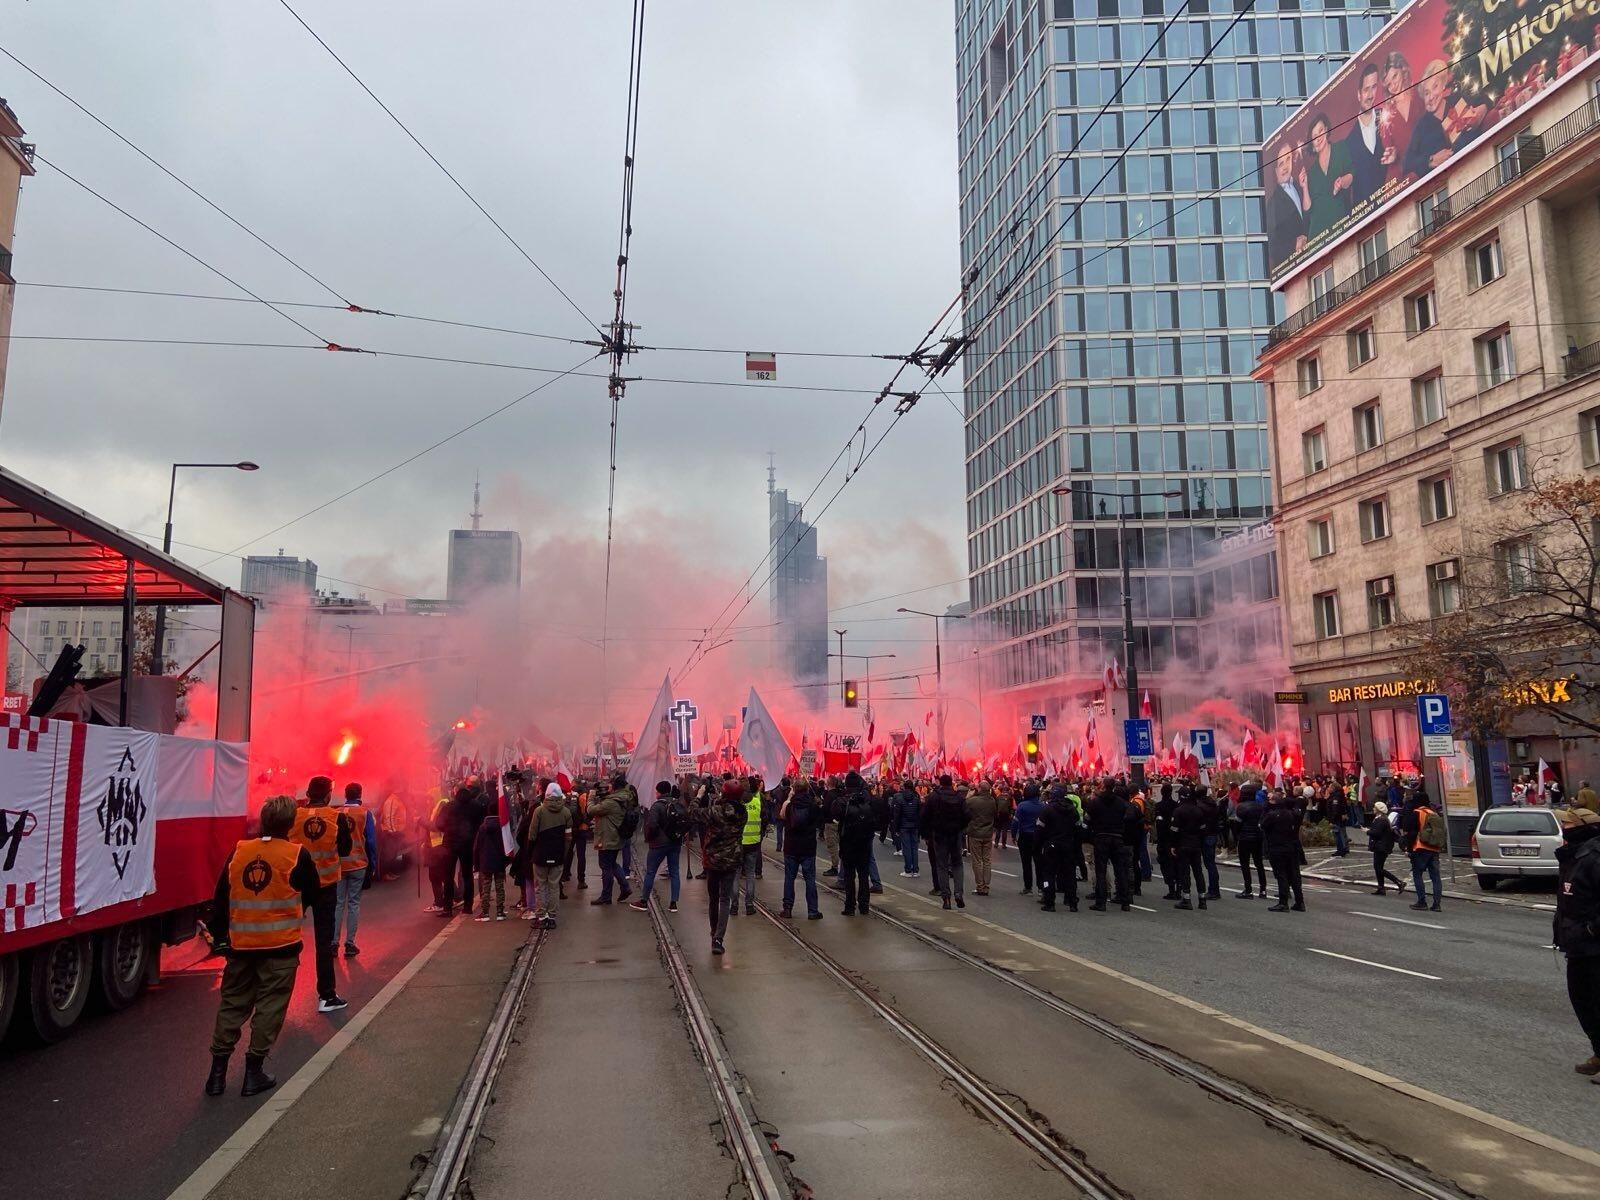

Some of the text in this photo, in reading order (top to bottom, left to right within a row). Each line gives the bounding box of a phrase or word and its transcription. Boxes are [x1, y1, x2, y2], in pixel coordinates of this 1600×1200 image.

[1351, 200, 1368, 215] ANNA
[756, 371, 770, 380] 162
[1329, 689, 1351, 703] BAR
[1425, 699, 1443, 723] P
[1196, 732, 1209, 749] P
